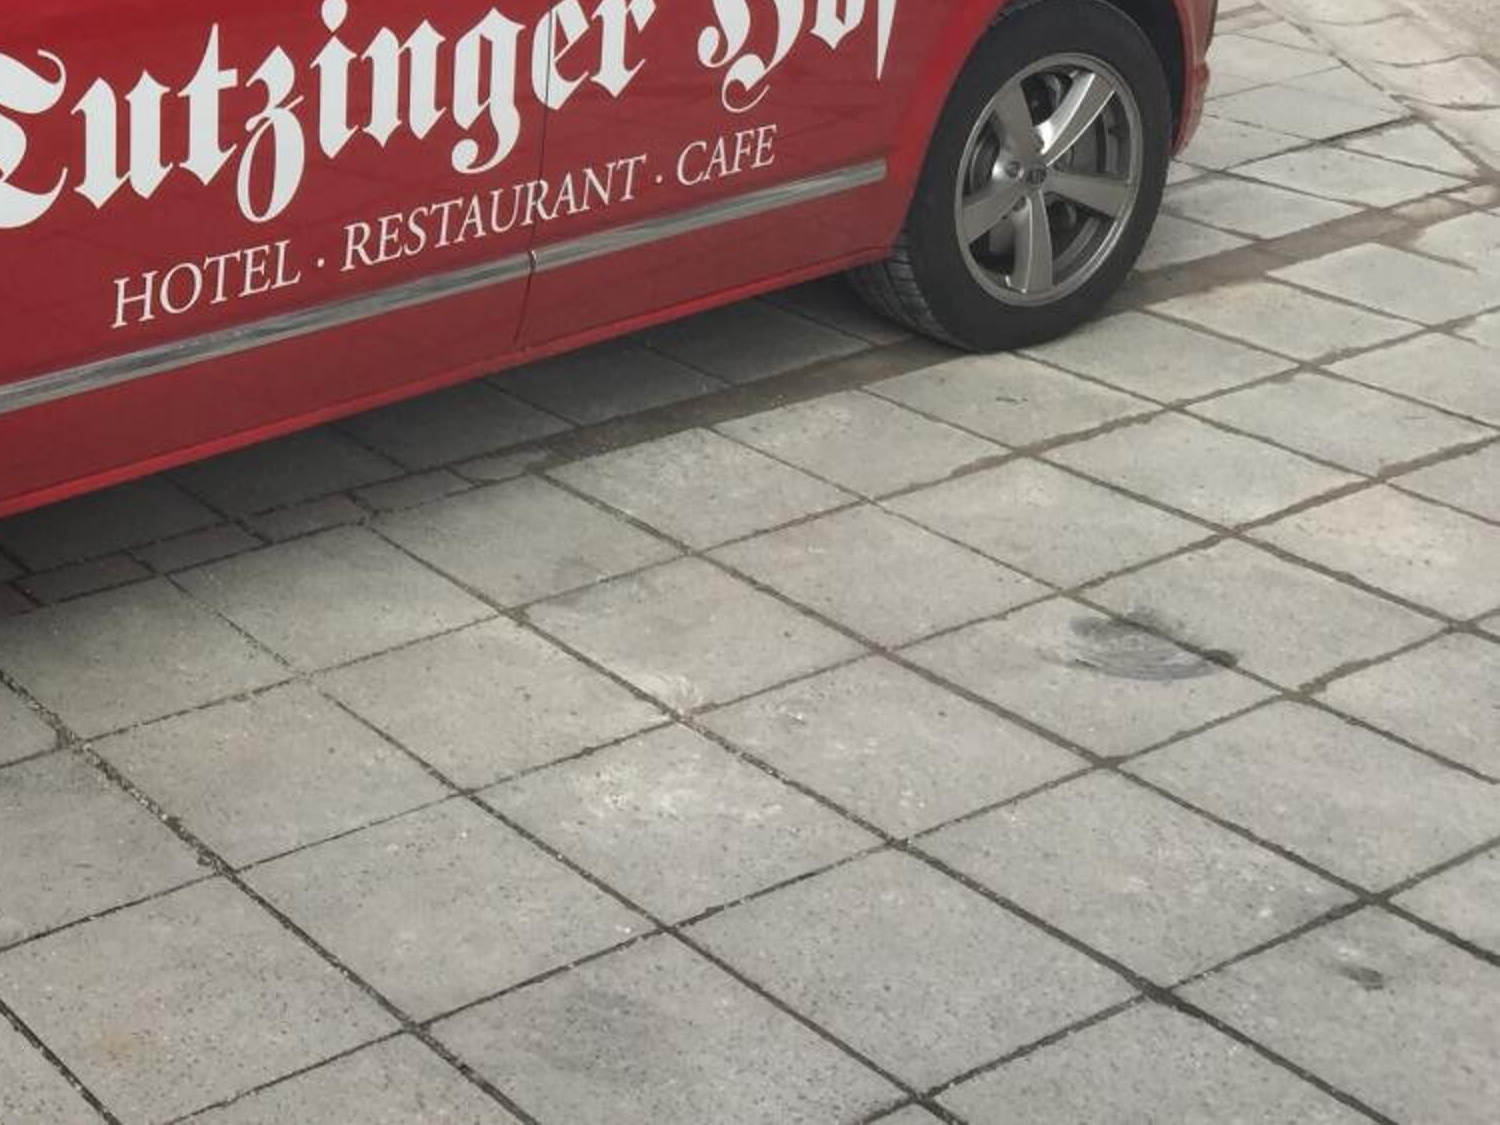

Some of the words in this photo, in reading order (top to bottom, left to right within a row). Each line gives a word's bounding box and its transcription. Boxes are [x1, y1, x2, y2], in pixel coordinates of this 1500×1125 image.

[110, 238, 303, 330] HOTEL
[339, 154, 647, 272] RESTAURANT
[675, 124, 778, 187] CAFE
